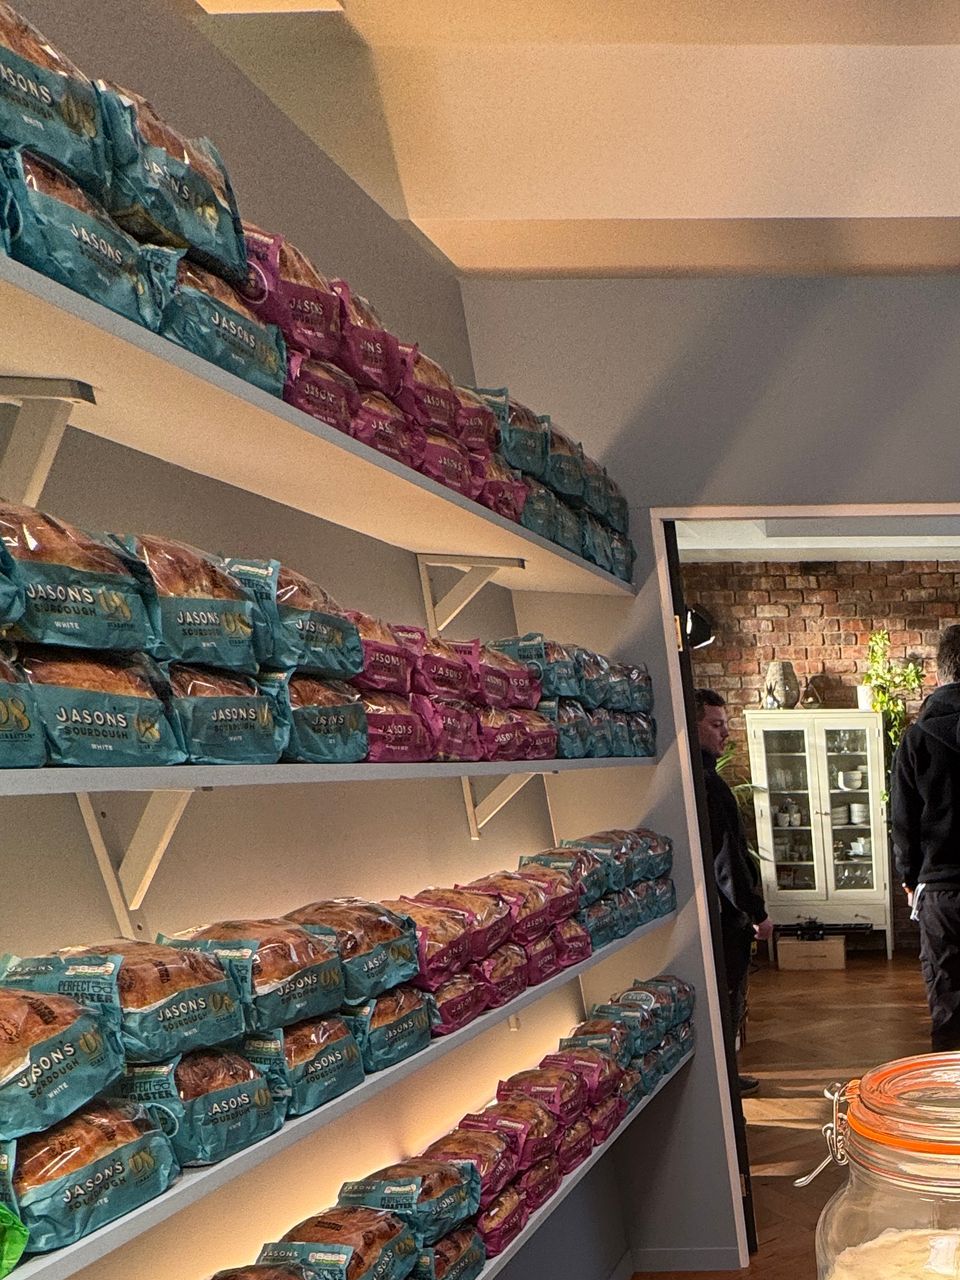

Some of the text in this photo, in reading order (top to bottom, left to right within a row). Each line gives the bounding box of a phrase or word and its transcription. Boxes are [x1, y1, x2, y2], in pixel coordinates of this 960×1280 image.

[0, 63, 51, 103] ASONS
[58, 980, 91, 993] PERFECT
[48, 1082, 69, 1098] WHITE
